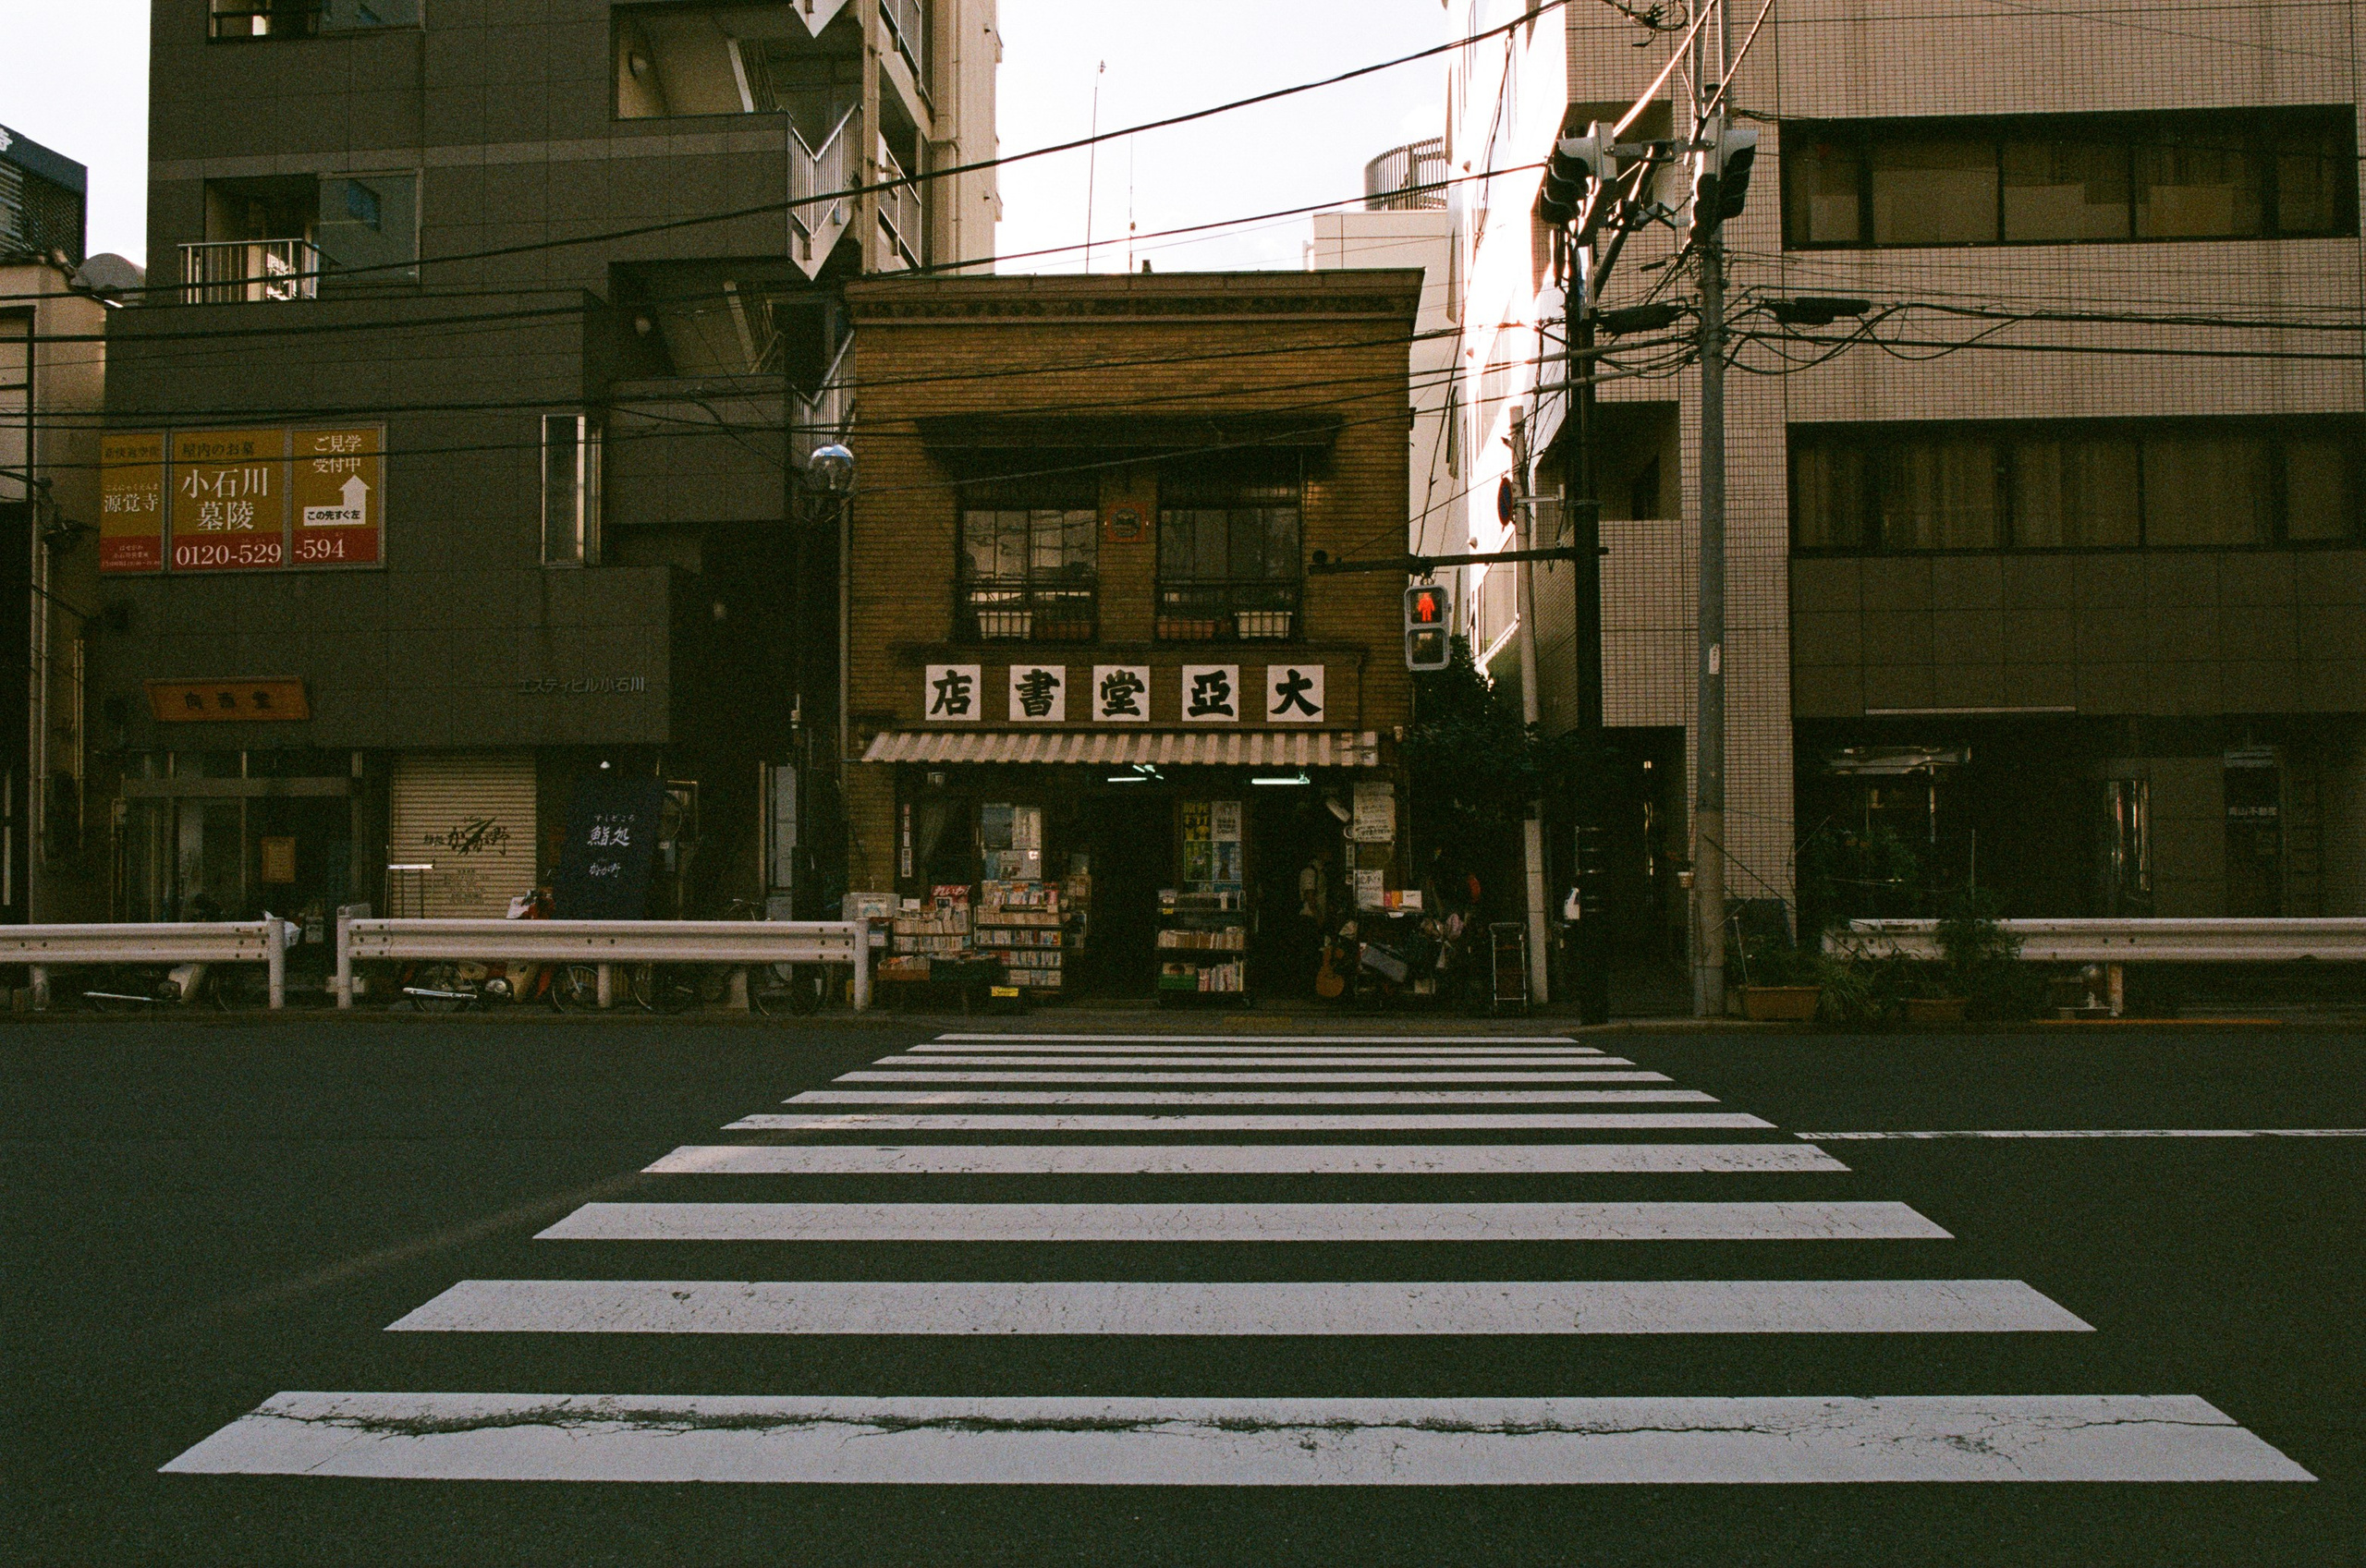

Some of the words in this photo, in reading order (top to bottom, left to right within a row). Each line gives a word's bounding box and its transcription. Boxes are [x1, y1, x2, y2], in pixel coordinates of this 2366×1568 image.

[183, 441, 255, 457] 屋内のお墓
[313, 434, 362, 453] ご見学
[312, 456, 361, 474] 受付中
[181, 467, 268, 499] 小石川
[104, 492, 159, 514] 源覚寺
[196, 501, 254, 531] 墓陵
[307, 509, 360, 521] この先すぐ左
[176, 543, 282, 565] 0120-529
[518, 675, 645, 694] エスティビル小石川
[586, 825, 631, 847] 鮨処
